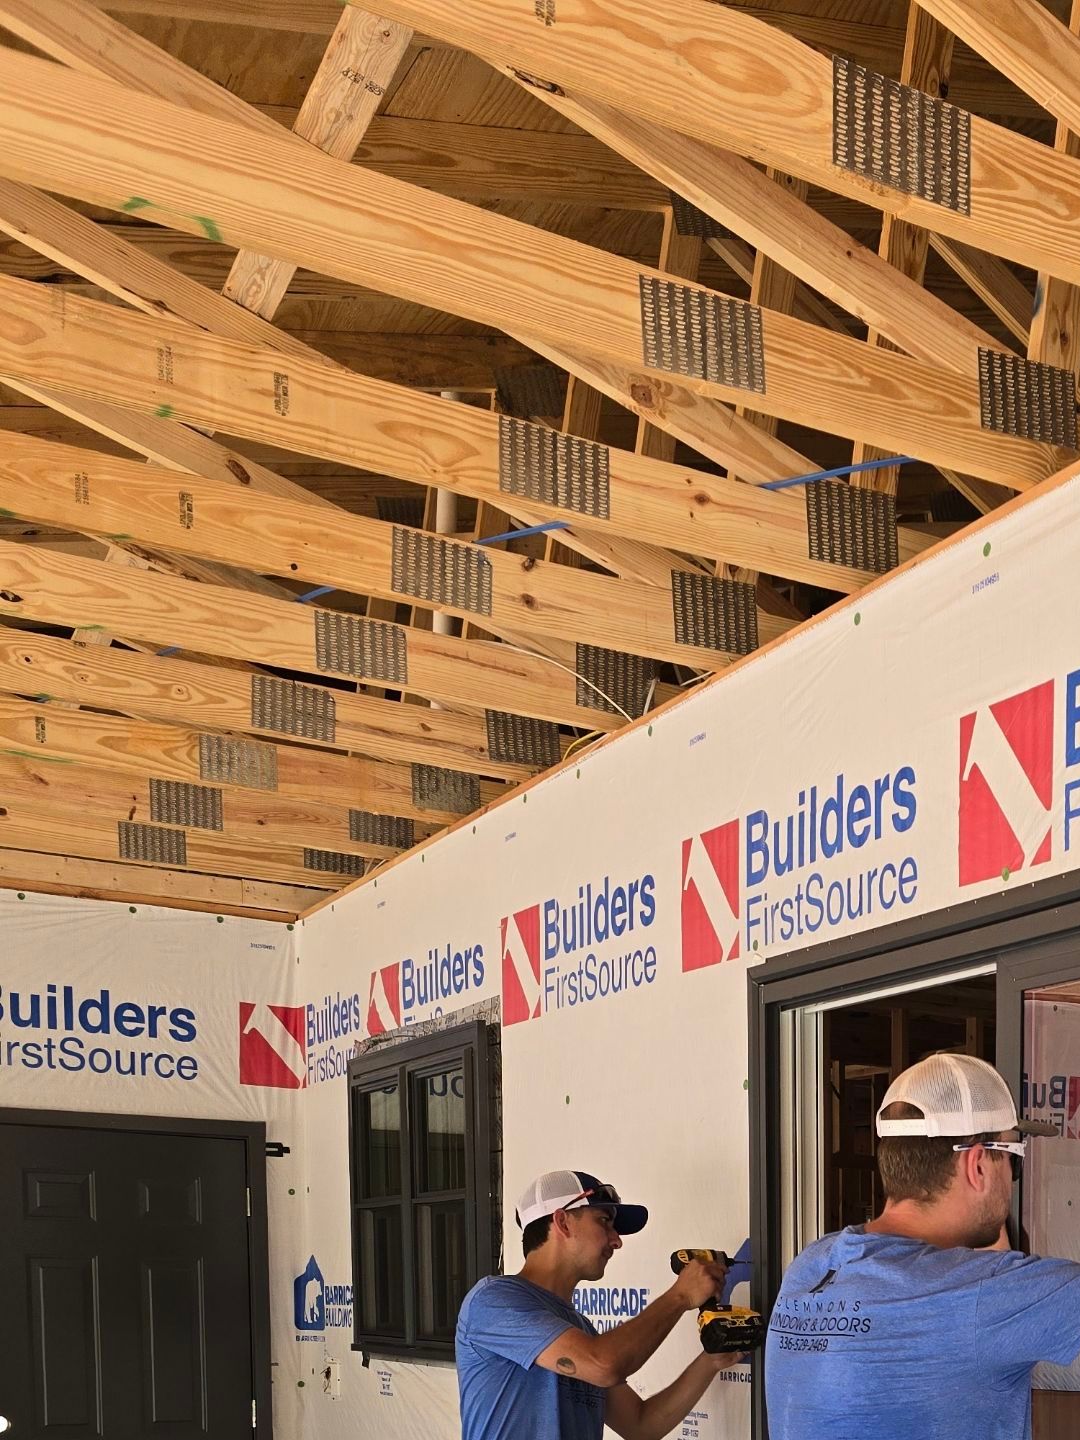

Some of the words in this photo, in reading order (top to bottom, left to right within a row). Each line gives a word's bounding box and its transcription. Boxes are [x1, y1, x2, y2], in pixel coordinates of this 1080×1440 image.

[745, 765, 918, 888] Builders
[544, 873, 657, 961] Builders
[745, 856, 919, 952] FirstSource
[401, 943, 486, 1010] Builders
[544, 945, 657, 1013] FirstSource
[0, 983, 197, 1043] uilders
[306, 991, 360, 1048] Builders
[0, 1032, 199, 1081] rstSource
[573, 1288, 647, 1317] BARRICADE
[819, 1317, 871, 1333] DOORS
